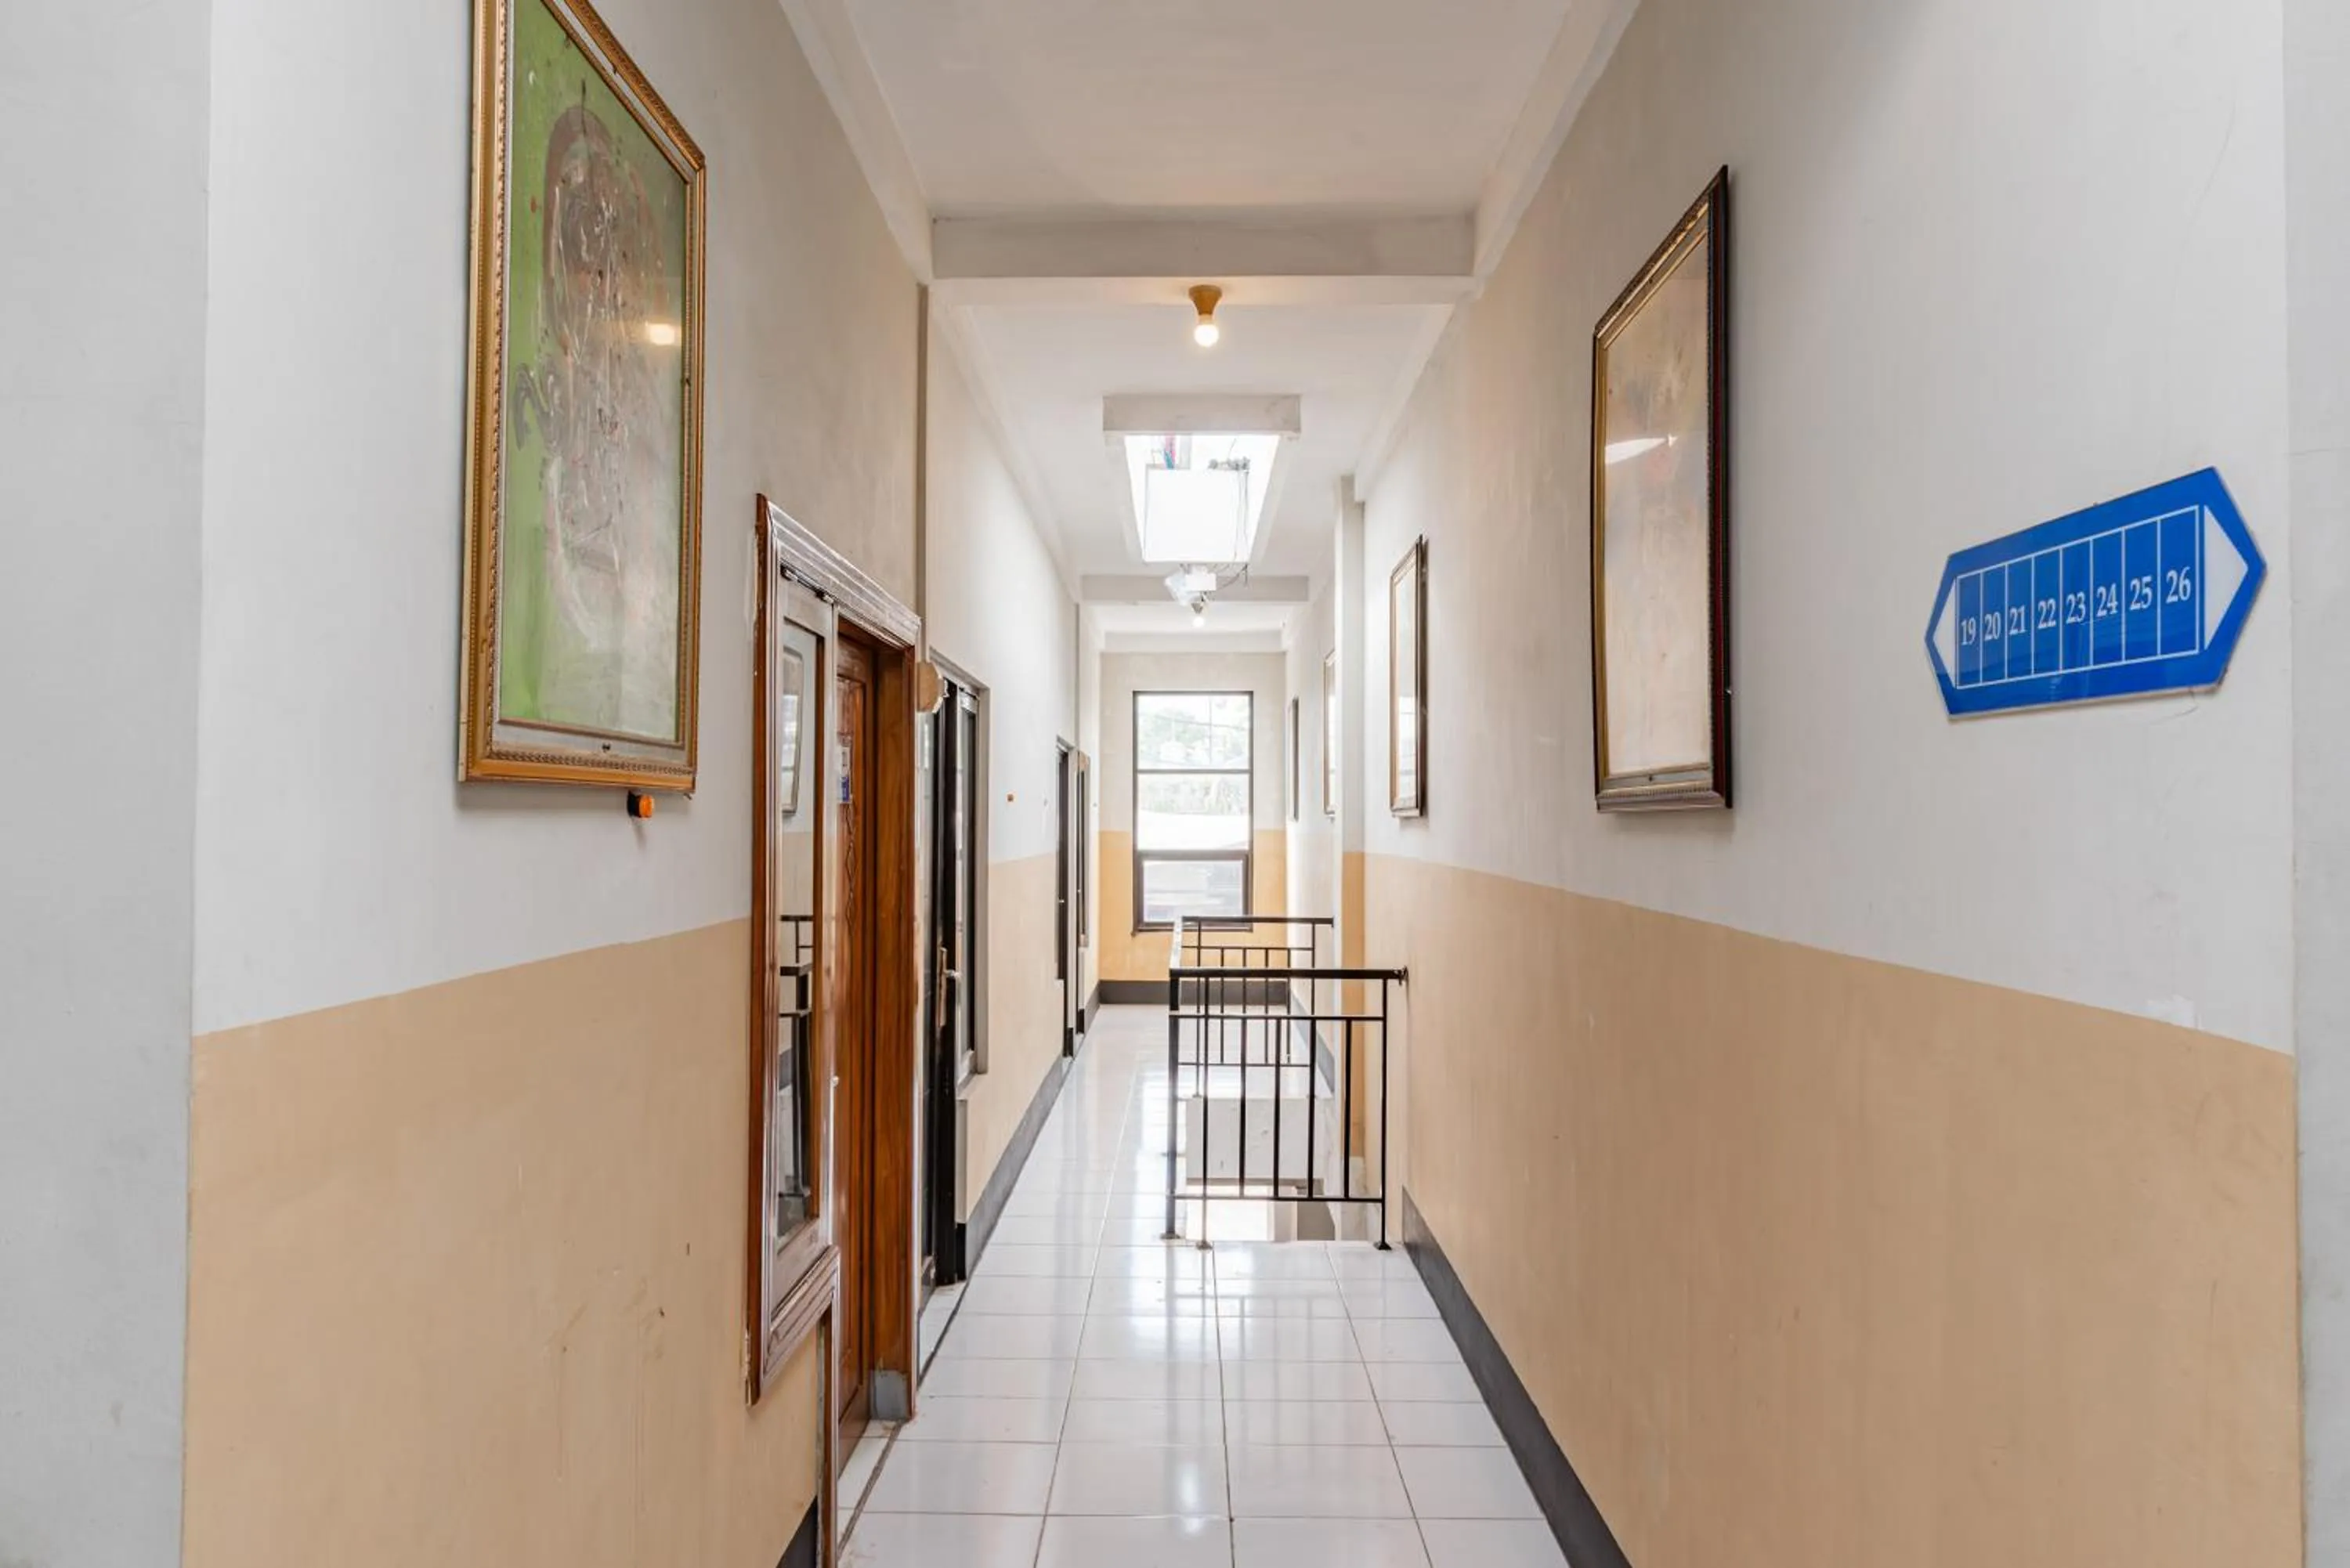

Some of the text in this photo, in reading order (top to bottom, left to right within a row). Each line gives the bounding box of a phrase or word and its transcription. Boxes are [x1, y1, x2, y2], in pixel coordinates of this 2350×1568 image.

[1961, 566, 2191, 645] 19 20 21 22 23 24 25 26
